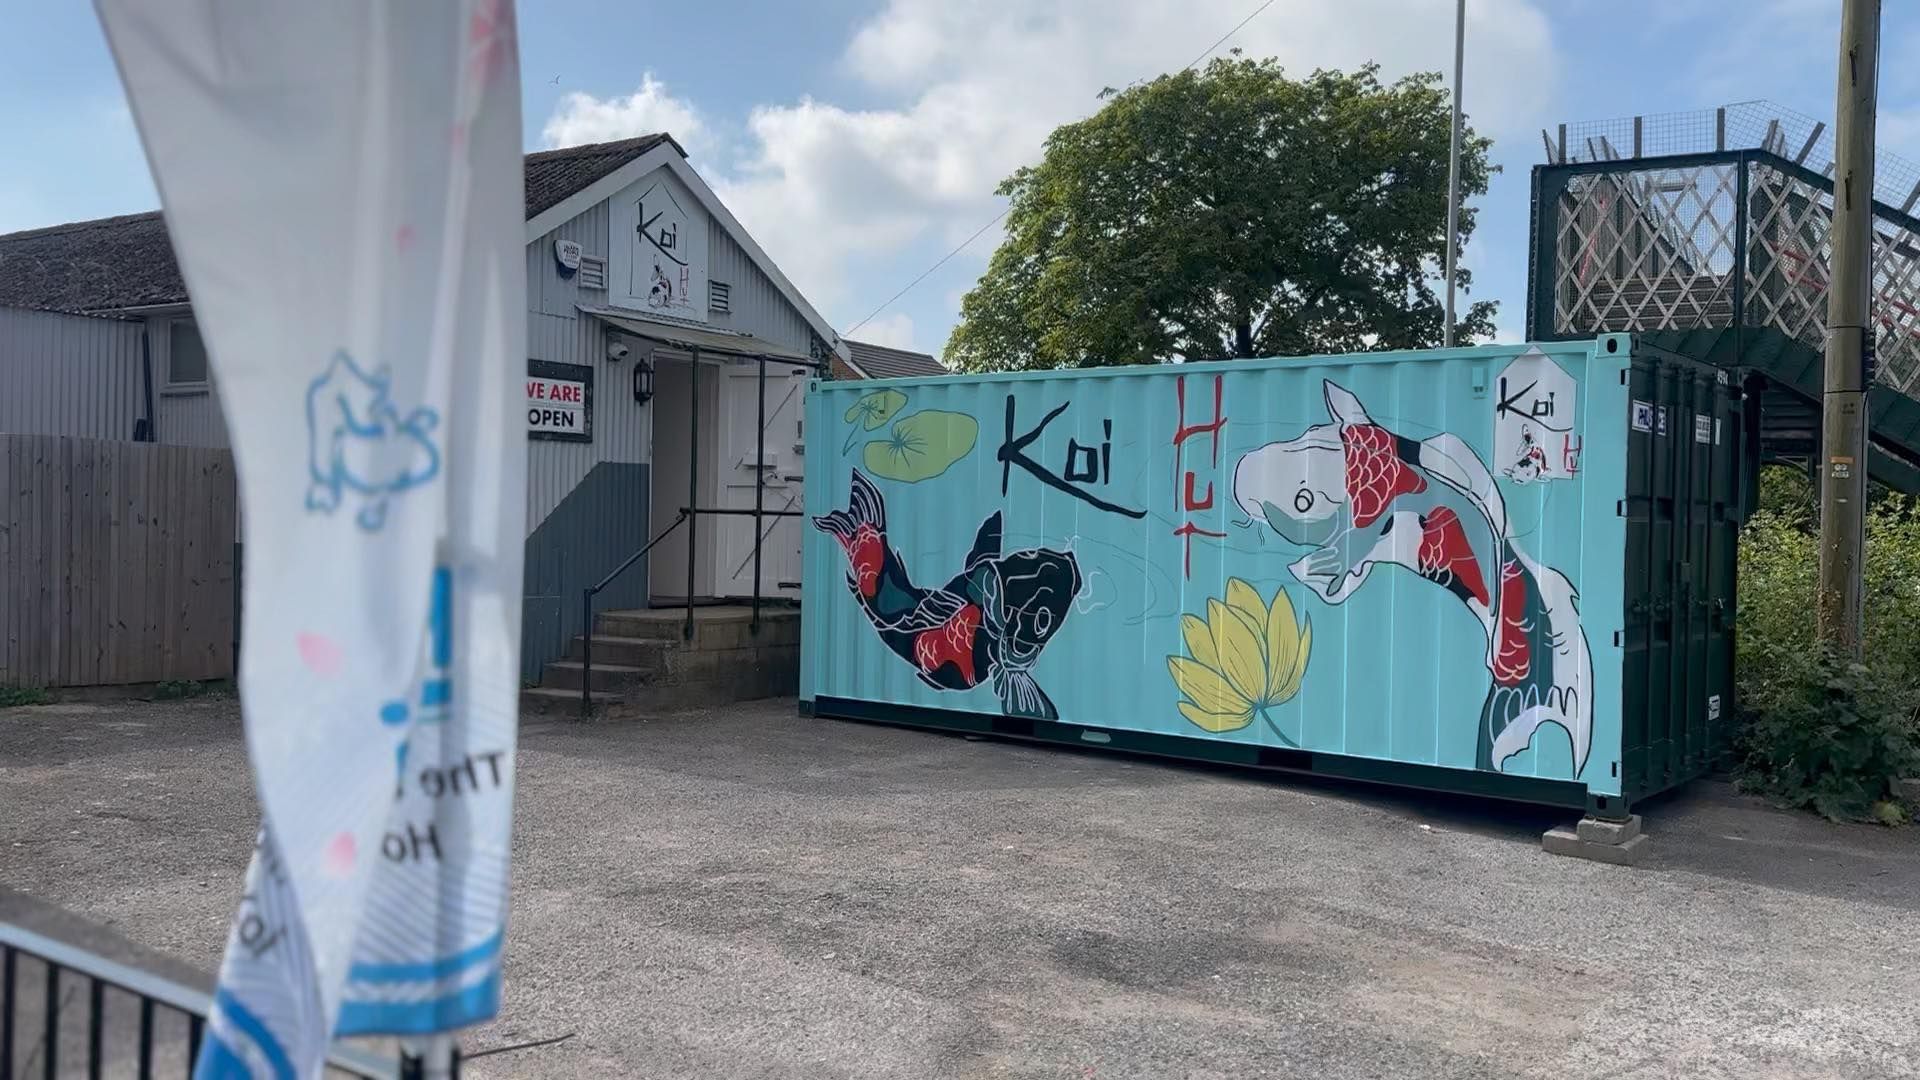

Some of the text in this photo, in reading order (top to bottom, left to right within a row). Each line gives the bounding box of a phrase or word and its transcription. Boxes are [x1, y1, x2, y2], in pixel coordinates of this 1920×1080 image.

[637, 202, 688, 266] Koi
[528, 409, 574, 427] OPEN
[550, 384, 581, 402] ARE
[1496, 376, 1573, 432] Koi
[997, 394, 1148, 519] Koi
